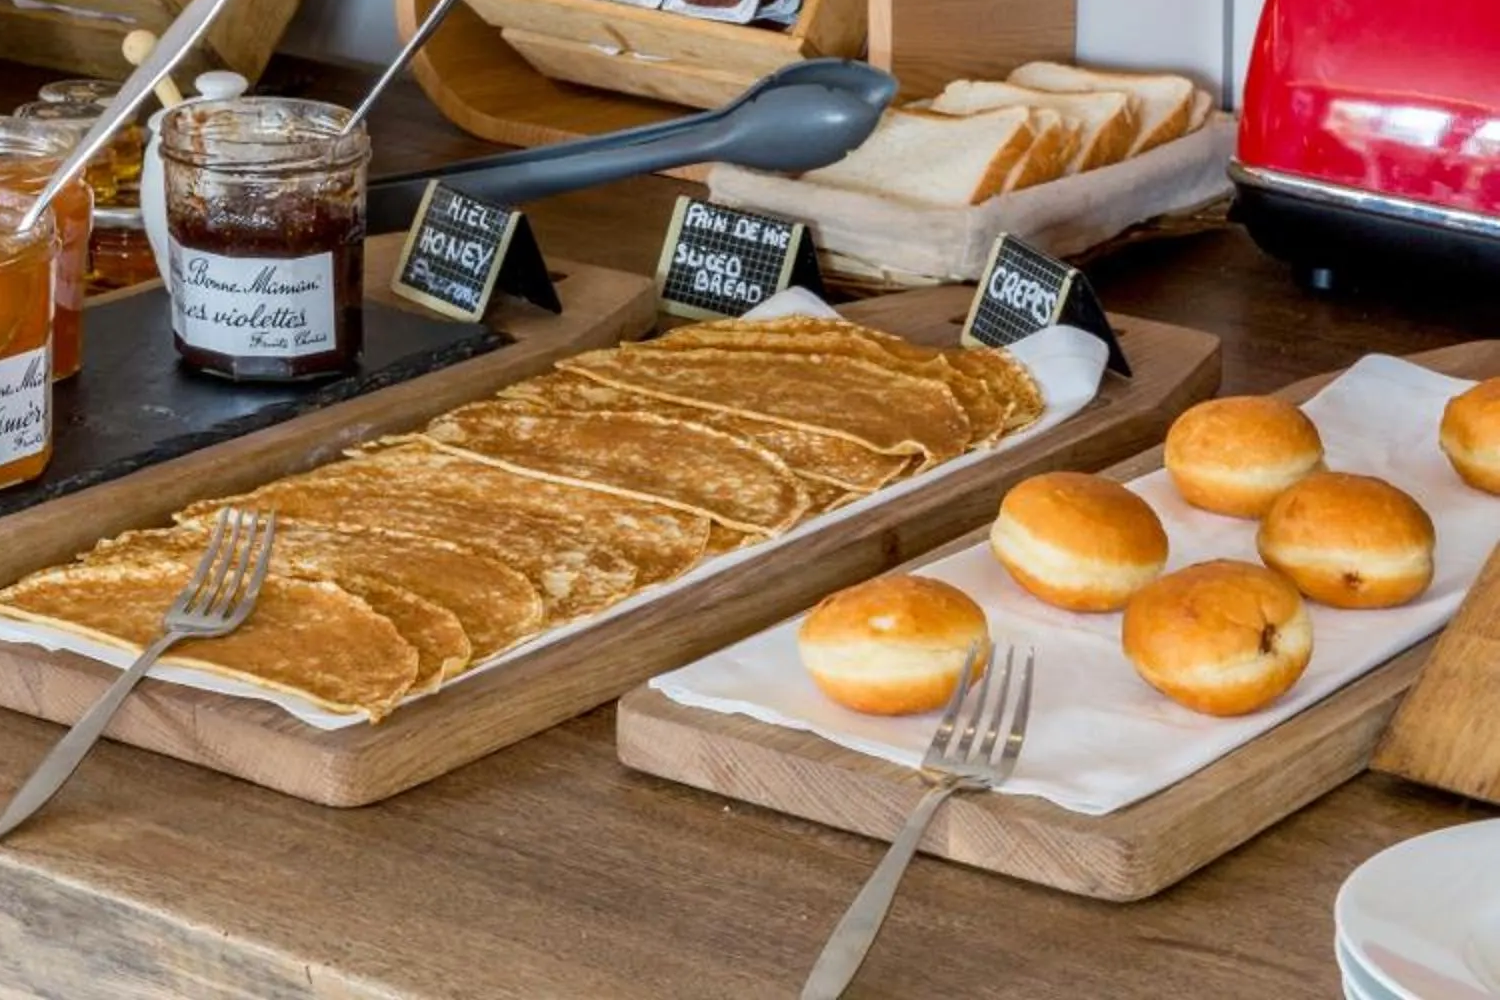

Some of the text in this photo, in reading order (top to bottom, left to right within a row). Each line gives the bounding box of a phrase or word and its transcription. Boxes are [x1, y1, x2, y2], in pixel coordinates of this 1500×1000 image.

[734, 217, 762, 242] DE
[419, 226, 495, 277] HONEY
[184, 257, 241, 294] Bonne
[243, 265, 317, 297] Maman
[693, 269, 762, 303] BREAD
[212, 304, 308, 330] violettes
